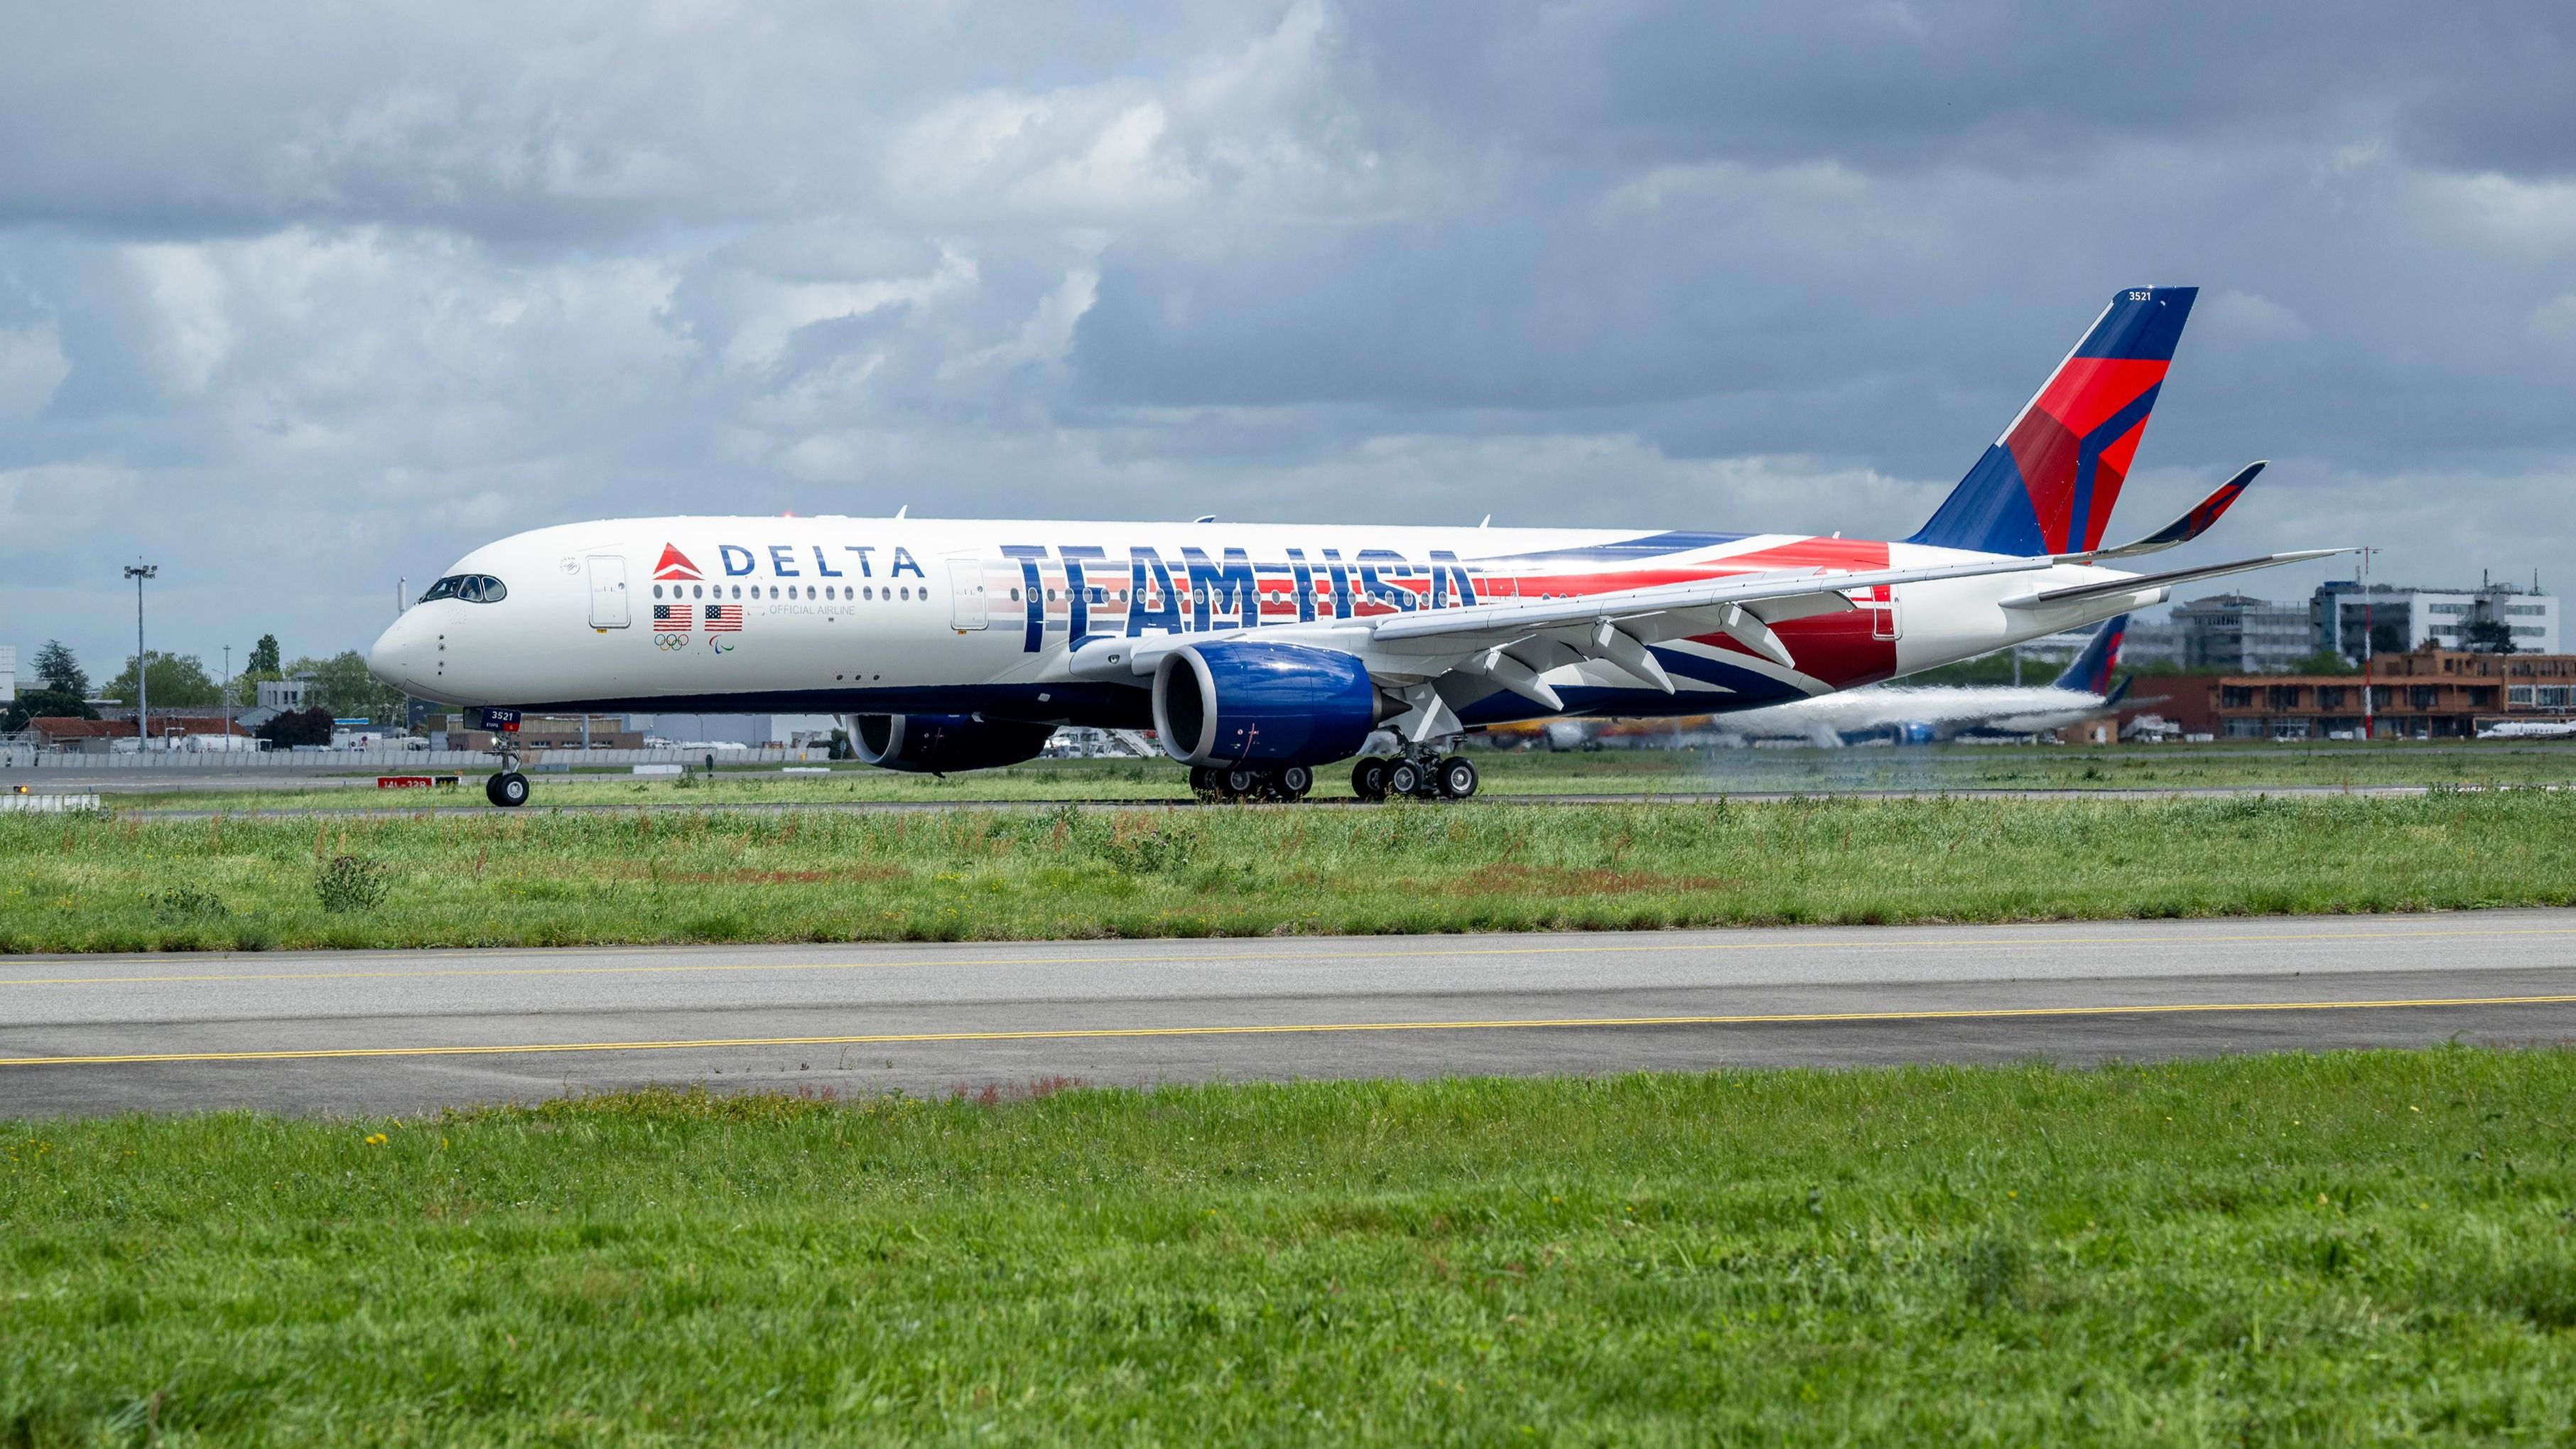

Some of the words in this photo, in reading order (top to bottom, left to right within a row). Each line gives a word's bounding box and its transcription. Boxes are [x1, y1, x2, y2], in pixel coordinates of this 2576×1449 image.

[2129, 291, 2150, 301] 3521
[718, 545, 926, 578] DELTA
[1000, 545, 1259, 653] TEAM
[769, 605, 815, 615] OFFICIAL
[817, 605, 855, 615] AIRLINE
[492, 711, 513, 721] 3521
